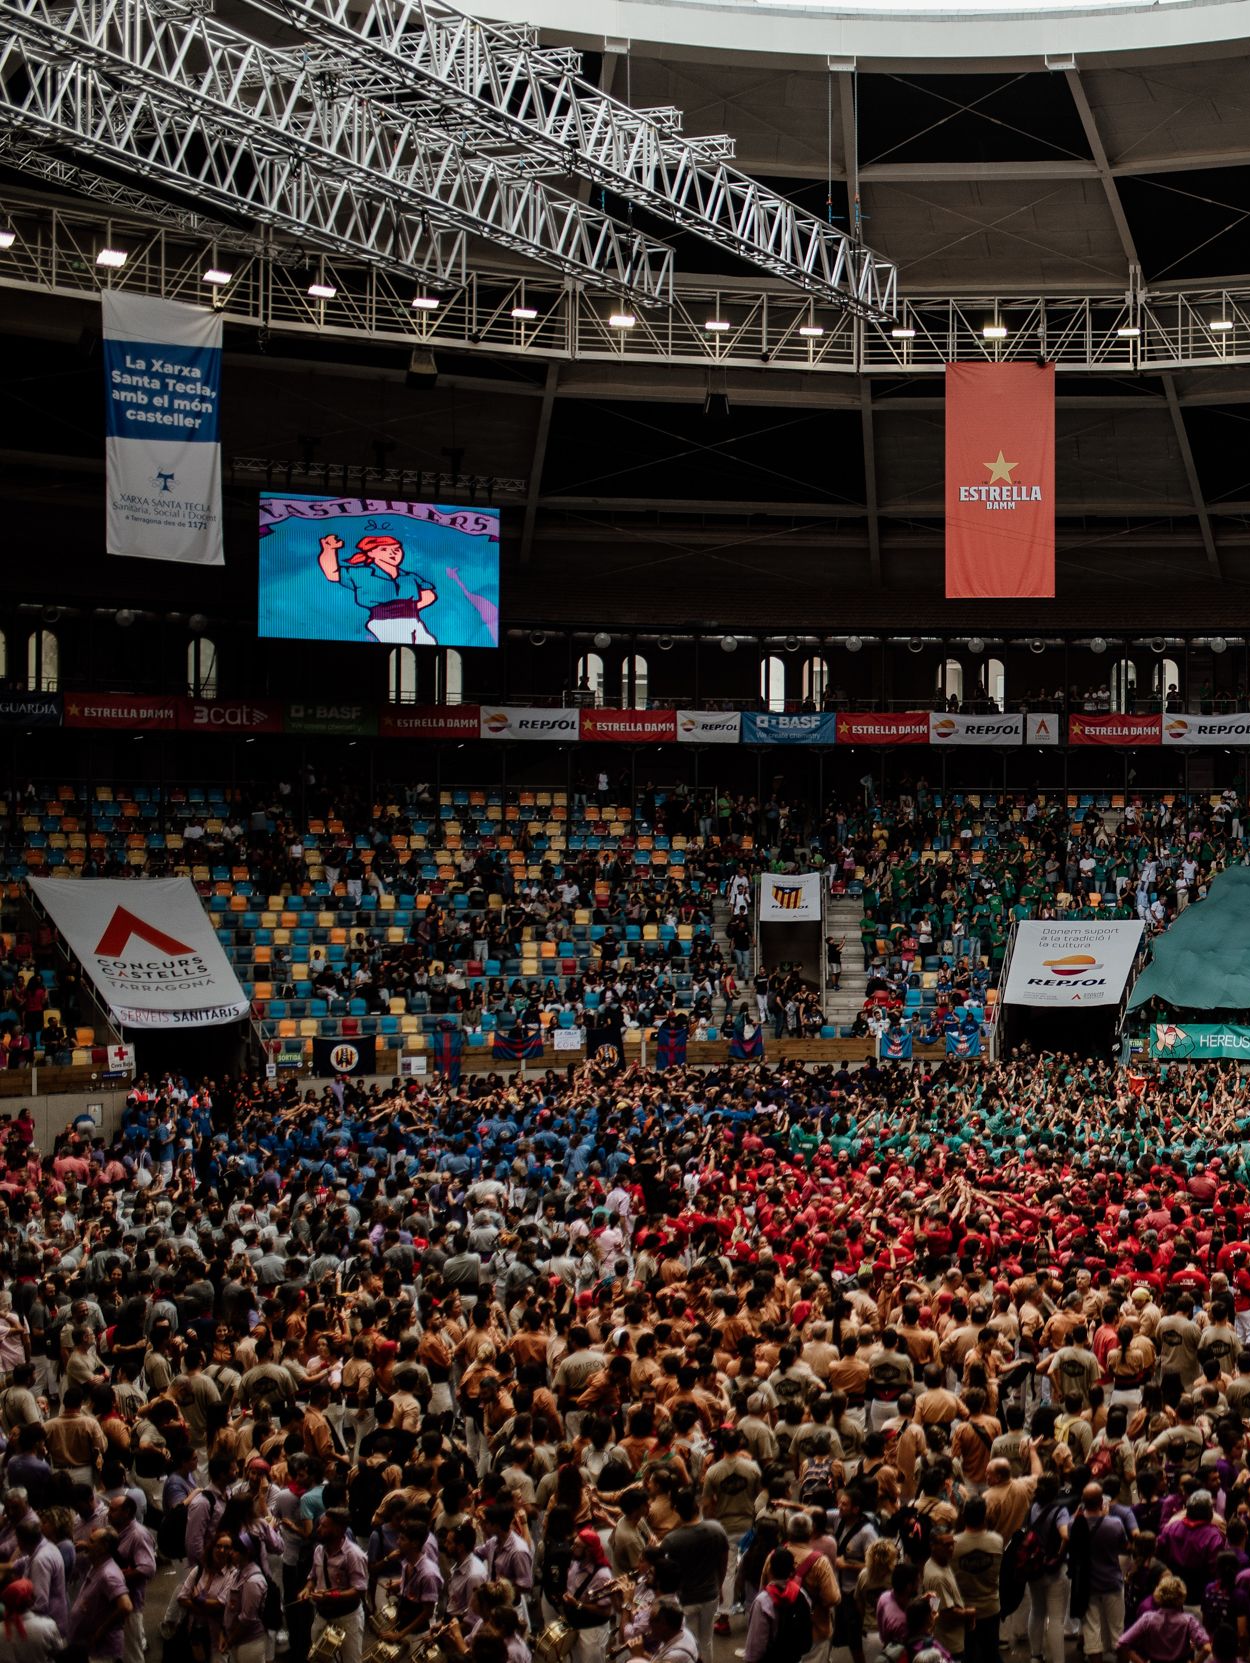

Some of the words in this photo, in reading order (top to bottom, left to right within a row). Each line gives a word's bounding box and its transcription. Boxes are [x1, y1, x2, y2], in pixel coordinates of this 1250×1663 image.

[125, 355, 146, 370] La
[151, 358, 202, 378] Xarxa
[111, 369, 161, 390] Santa
[164, 379, 216, 399] Tecla,
[111, 389, 149, 405] amb
[152, 394, 169, 408] el
[173, 398, 213, 413] món
[125, 409, 202, 429] casteller
[959, 486, 1042, 501] ESTRELLA
[120, 493, 150, 506] XARXA
[152, 499, 182, 509] SANTA
[986, 501, 1016, 510] DAMM
[153, 507, 180, 518] Social
[364, 519, 394, 531] de
[84, 707, 136, 718] ESTRELLA
[139, 708, 174, 719] DAMM
[193, 705, 250, 725] 3cat
[315, 706, 362, 719] BASF
[397, 718, 444, 728] ESTRELLA
[446, 718, 478, 728] DAMM
[518, 719, 577, 730] REPSOL
[596, 722, 641, 732] ESTRELLA
[644, 722, 675, 732] DAMM
[701, 723, 738, 731] REPSOL
[778, 716, 821, 729] BASF
[852, 725, 896, 734] ESTRELLA
[898, 725, 928, 734] DAMM
[965, 725, 1020, 735] REPSOL
[1084, 726, 1129, 735] ESTRELLA
[1130, 727, 1160, 735] DAMM
[97, 957, 203, 970] CONCURS
[102, 965, 208, 979] CASTELLS
[108, 979, 215, 992] TARRAGONA
[1027, 978, 1106, 986] REPSOL
[120, 1009, 170, 1023] SERVEIS
[172, 1007, 240, 1022] SANITARIS
[1200, 1035, 1250, 1048] HEREUS
